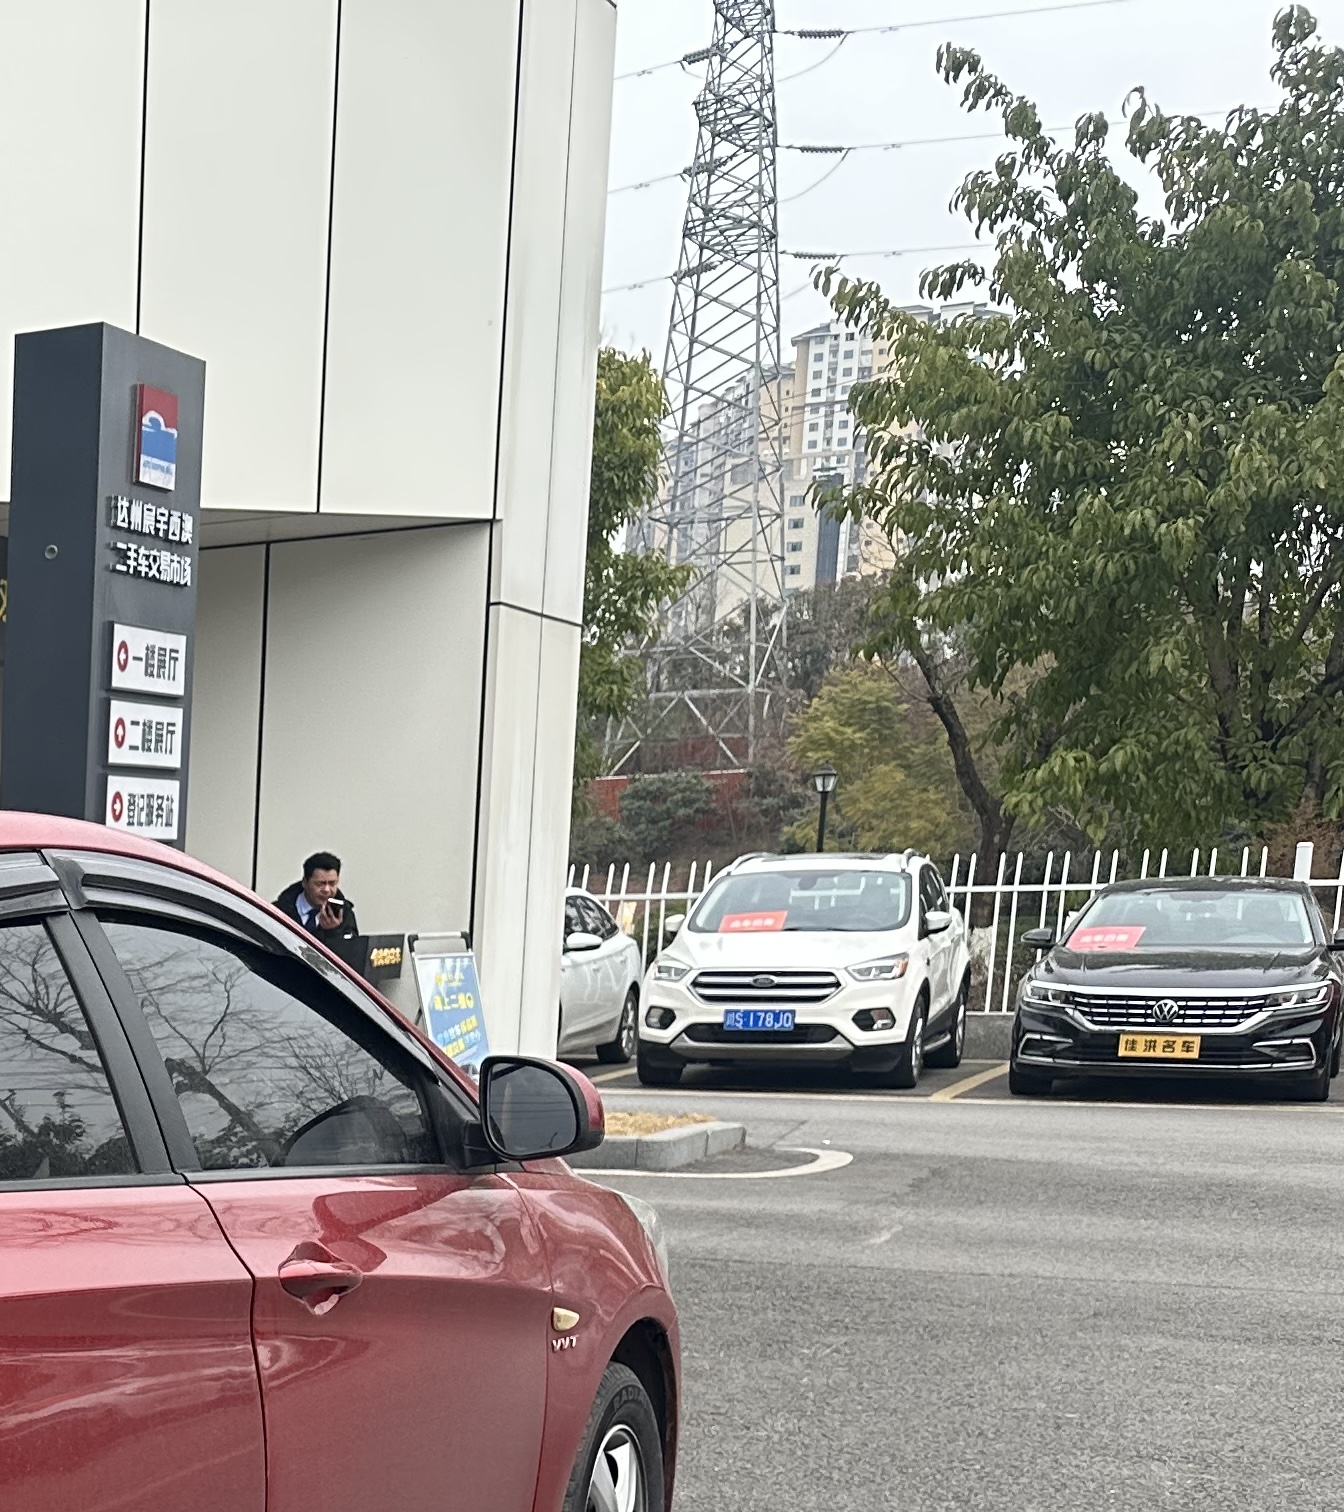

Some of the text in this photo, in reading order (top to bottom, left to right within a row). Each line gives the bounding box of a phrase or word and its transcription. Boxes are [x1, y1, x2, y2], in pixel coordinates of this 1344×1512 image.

[115, 541, 192, 587] 二手车交易市场
[1124, 1038, 1195, 1054] 佳洪名车
